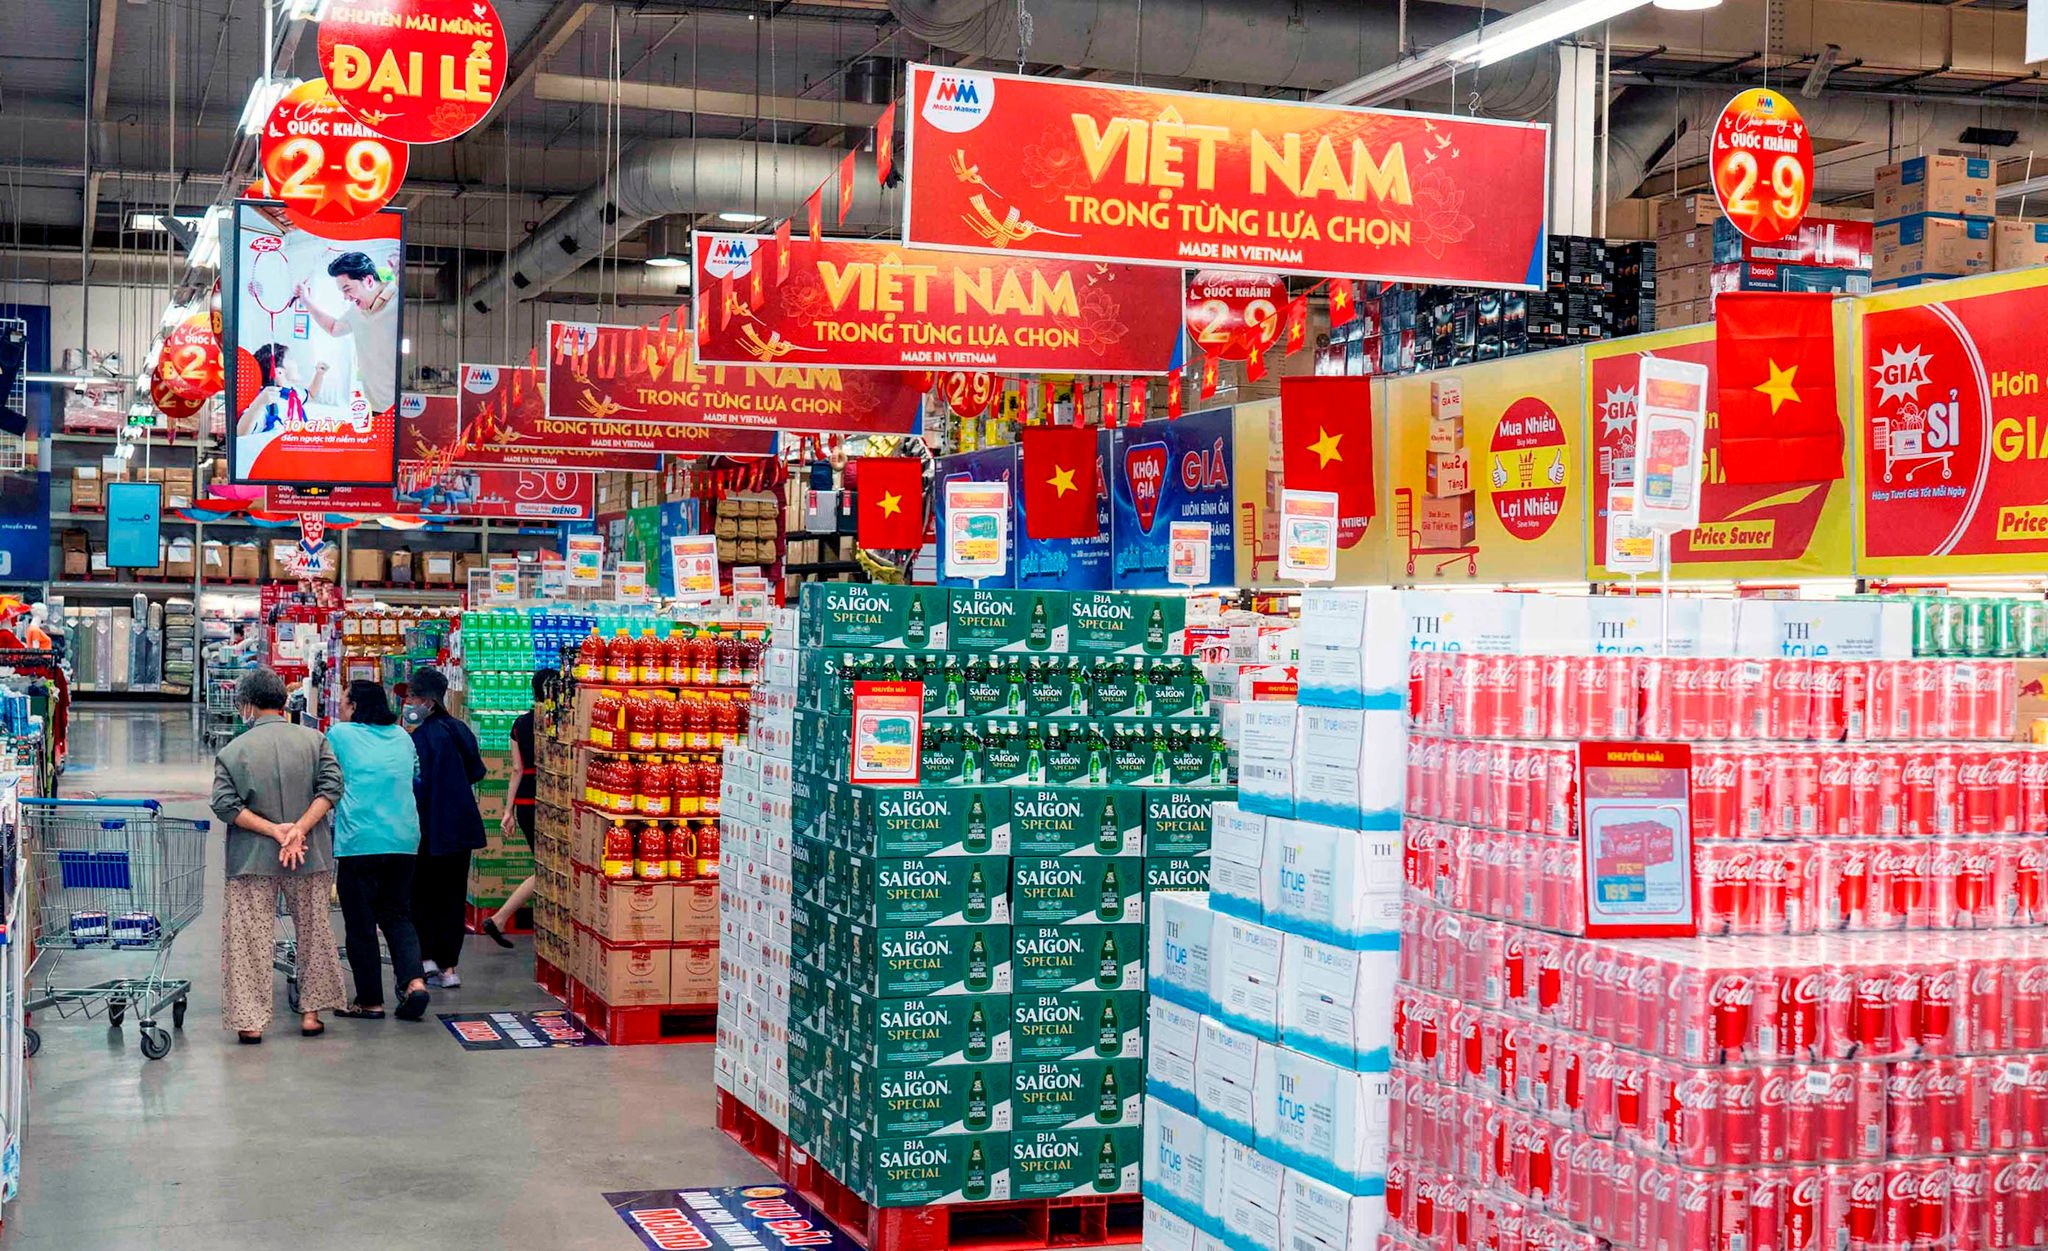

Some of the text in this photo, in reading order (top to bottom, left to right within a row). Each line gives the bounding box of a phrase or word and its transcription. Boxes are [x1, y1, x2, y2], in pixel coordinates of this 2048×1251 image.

[331, 6, 493, 37] KHUYẾN MÃI MỪNG
[329, 40, 493, 104] ĐẠI LỄ
[287, 117, 329, 136] QUỐC
[1730, 130, 1798, 153] QUỐC KHÁNH
[1071, 105, 1413, 207] VIỆT NAM
[279, 137, 393, 202] 2-9
[1726, 151, 1805, 219] 2-9
[1064, 195, 1411, 250] TRONG TỪNG LỰA CHỌN
[1178, 241, 1303, 264] MADE IN VIETNAM
[817, 252, 1081, 323] VIỆT NAM
[1203, 284, 1271, 298] QUỐC KHÁNH
[813, 320, 1080, 351] TRONG TỪNG LỰA CHỌN
[901, 351, 997, 364] MADE IN VIETNAM
[1883, 357, 1924, 386] GIÁ
[1991, 370, 2039, 398] Hơn
[636, 389, 842, 416] TRONG TỪNG LỰA CHỌN
[285, 420, 303, 432] 10
[703, 413, 777, 425] MADE IN VIETNAM
[1499, 411, 1557, 438] Mua Nhiều
[1926, 388, 1960, 449] SỈ
[534, 419, 710, 440] TRONG CHỌN
[591, 439, 655, 448] MADE IN VIETNAM
[1516, 437, 1537, 447] Buy More
[1132, 456, 1160, 479] KHÓA
[1181, 436, 1229, 491] GIÁ
[1442, 454, 1461, 470] Mua 2
[1137, 478, 1155, 500] GIÁ
[1872, 484, 1968, 502] Hàng Tươi Giá Tốt Mỗi Ngày
[551, 503, 577, 515] RIÊNG
[1181, 495, 1230, 517] LUÔN BÌNH ỔN
[1501, 492, 1558, 522] Lợi Nhiều
[304, 520, 322, 531] CÓ
[1517, 519, 1540, 528] Save More
[1692, 526, 1772, 545] Price Saver
[849, 587, 869, 597] BIA
[974, 591, 993, 601] BIA
[1093, 594, 1112, 604] BIA
[826, 595, 891, 612] SAIGON
[952, 600, 1014, 616] SAIGON
[1072, 602, 1132, 619] SAIGON
[833, 613, 884, 624] SPECIAL
[959, 616, 1008, 627] SPECIAL
[1078, 619, 1125, 631] SPECIAL
[1412, 615, 1440, 634] TH
[1597, 621, 1624, 638] TH
[1783, 622, 1809, 640] TH
[1032, 688, 1063, 697] SAIGON
[1098, 689, 1127, 697] SAIGON
[922, 757, 954, 765] SAIGON
[1050, 757, 1081, 765] SAIGON
[1116, 757, 1146, 765] SAIGON
[1607, 748, 1664, 762] KHUYẾN MÃI
[903, 791, 924, 800] BIA
[1037, 792, 1058, 801] BIA
[1171, 794, 1191, 803] BIA
[879, 800, 948, 817] SAIGON
[1014, 802, 1081, 817] SAIGON
[1149, 804, 1212, 819] SAIGON
[886, 819, 942, 829] SPECIAL
[1021, 819, 1076, 830] SPECIAL
[1155, 821, 1208, 831] SPECIAL
[1283, 845, 1296, 865] TH
[1280, 865, 1305, 892] true
[905, 930, 926, 940] BIA
[1039, 928, 1059, 938] BIA
[1166, 919, 1179, 938] TH
[881, 940, 949, 958] SAIGON
[1016, 938, 1081, 954] SAIGON
[1165, 938, 1188, 965] true
[888, 958, 944, 970] SPECIAL
[1023, 956, 1075, 967] SPECIAL
[1280, 1073, 1294, 1094] TH
[1278, 1092, 1305, 1124] true
[1160, 1124, 1173, 1144] TH
[1160, 1142, 1182, 1172] true
[629, 1208, 713, 1250] MCARD
[742, 1198, 832, 1247] ƯU ĐÃI
